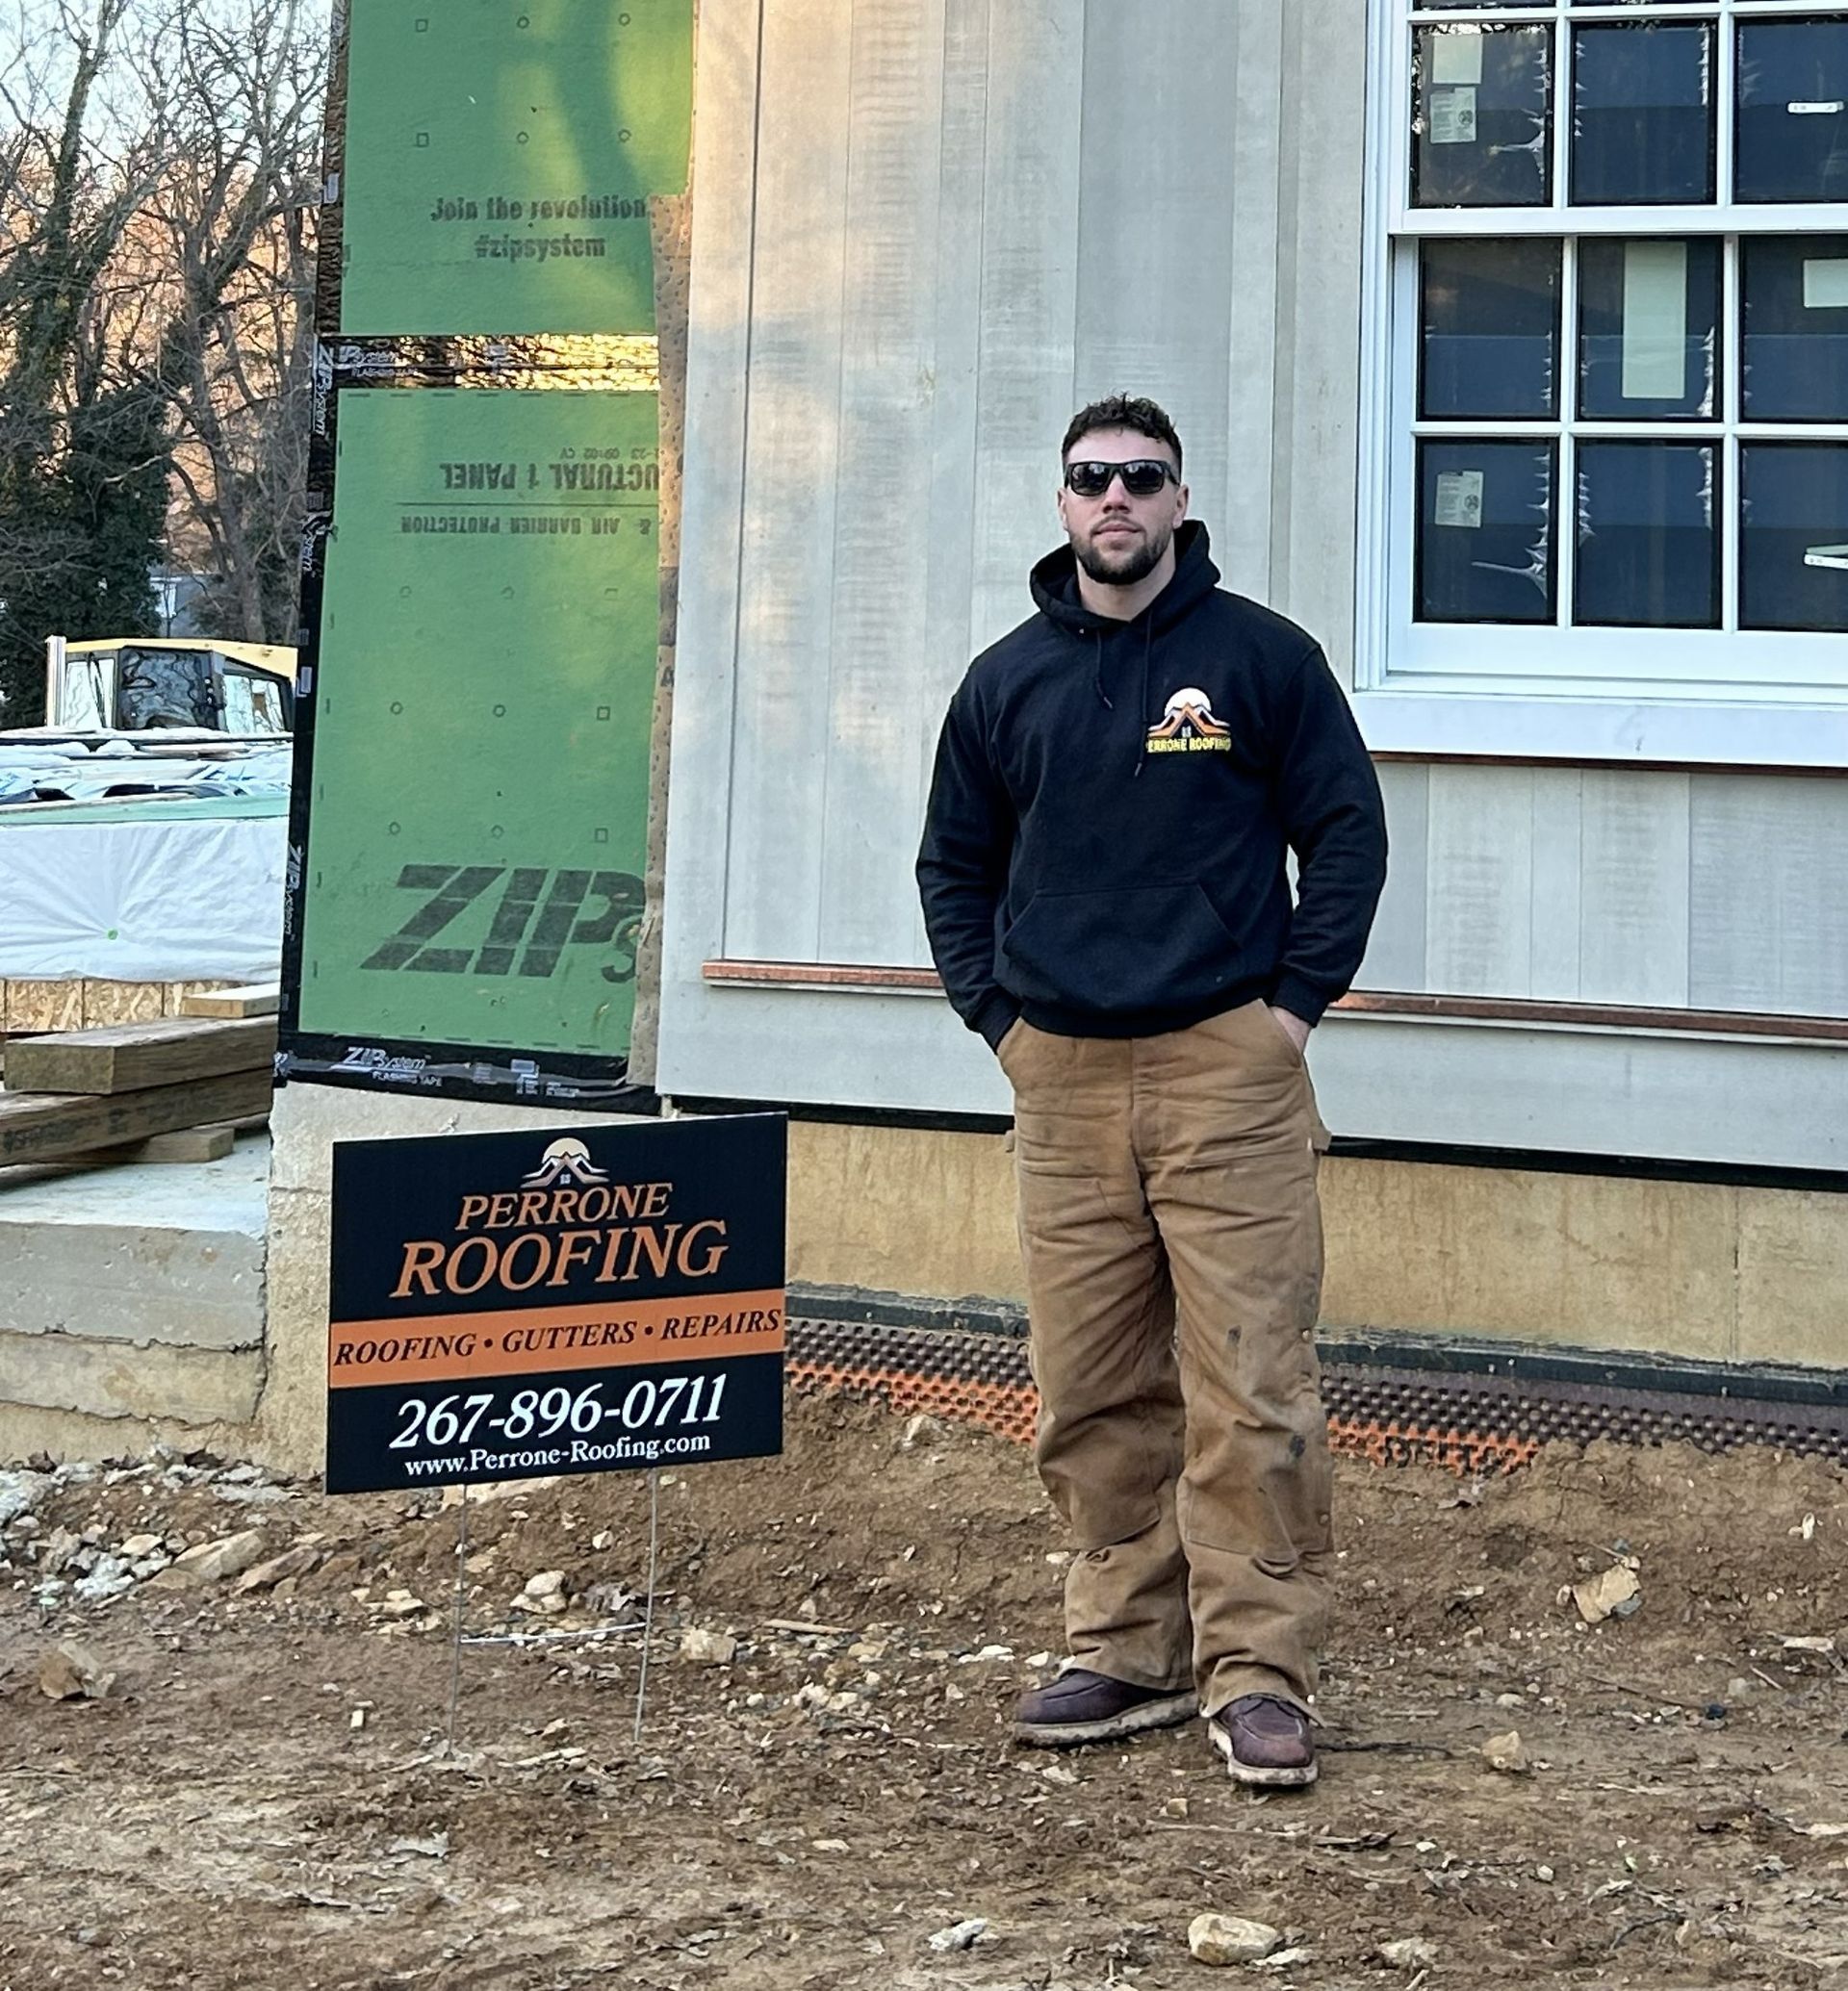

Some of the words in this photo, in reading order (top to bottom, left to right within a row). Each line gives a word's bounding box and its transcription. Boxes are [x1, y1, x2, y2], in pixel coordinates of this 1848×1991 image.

[430, 197, 478, 222] Join
[486, 195, 523, 220] the
[529, 194, 648, 220] revolution
[474, 233, 606, 264] #zipsystem
[438, 462, 517, 490] PANEL
[400, 515, 500, 534] PROTECTION
[509, 516, 581, 535] BARRIER
[591, 516, 621, 535] AIR
[638, 518, 653, 535] &
[1145, 738, 1187, 753] ERRONE
[454, 1183, 673, 1231] PERRONE
[389, 1219, 730, 1299] ROOFING
[333, 1333, 477, 1366] ROOFING
[501, 1319, 638, 1354] GUTTERS
[660, 1308, 782, 1341] REPAIRS
[389, 1373, 728, 1449] 267-896-0711
[404, 1433, 710, 1477] www.Perrone-Roofing.com
